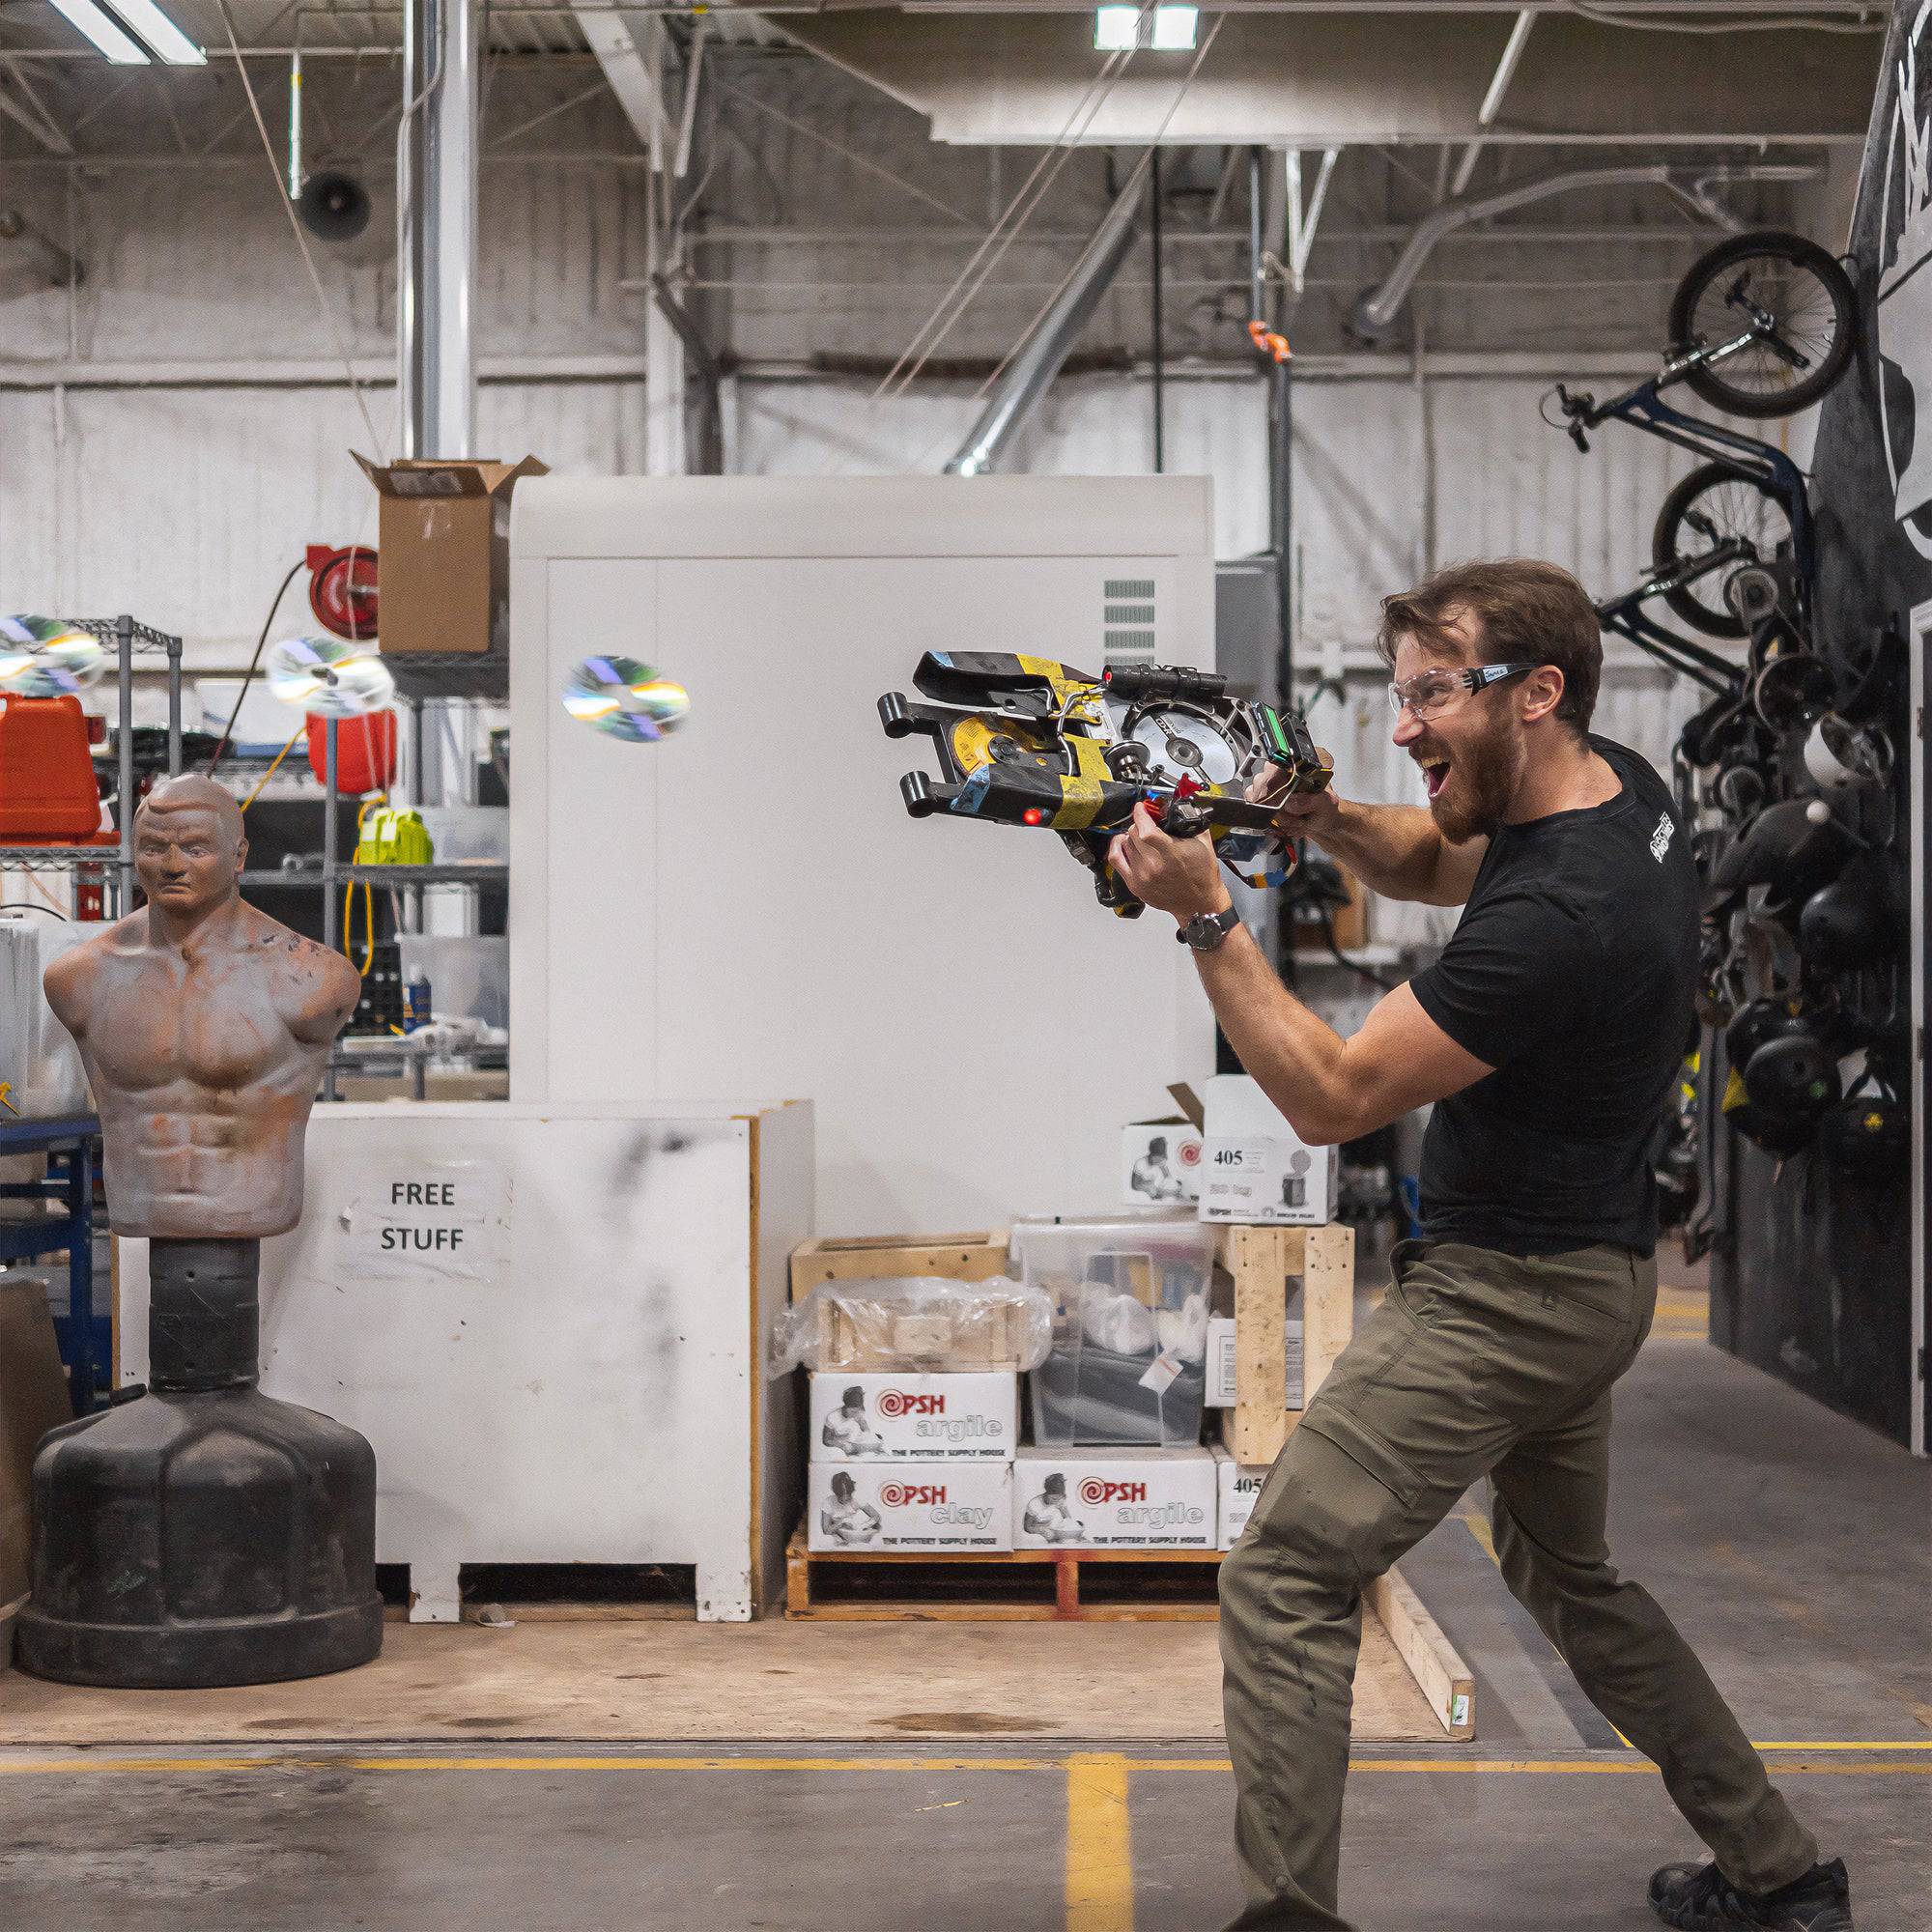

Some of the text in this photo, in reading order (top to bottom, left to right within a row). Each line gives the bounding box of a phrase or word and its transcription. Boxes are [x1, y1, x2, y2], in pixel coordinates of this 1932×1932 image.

[1214, 1150, 1243, 1165] 405
[391, 1182, 455, 1206] FREE
[381, 1228, 464, 1251] STUFF
[902, 1394, 946, 1415] PSH
[916, 1414, 1003, 1442] argile
[903, 1485, 947, 1505] PSH
[1103, 1482, 1147, 1503] PSH
[1233, 1478, 1262, 1493] 405
[930, 1501, 994, 1530] clay
[1117, 1501, 1205, 1530] argile
[882, 1537, 997, 1546] THE POTTERY SUPPLY HOUSE
[1093, 1536, 1208, 1545] THE POTTERY SUPPLY HOUSE
